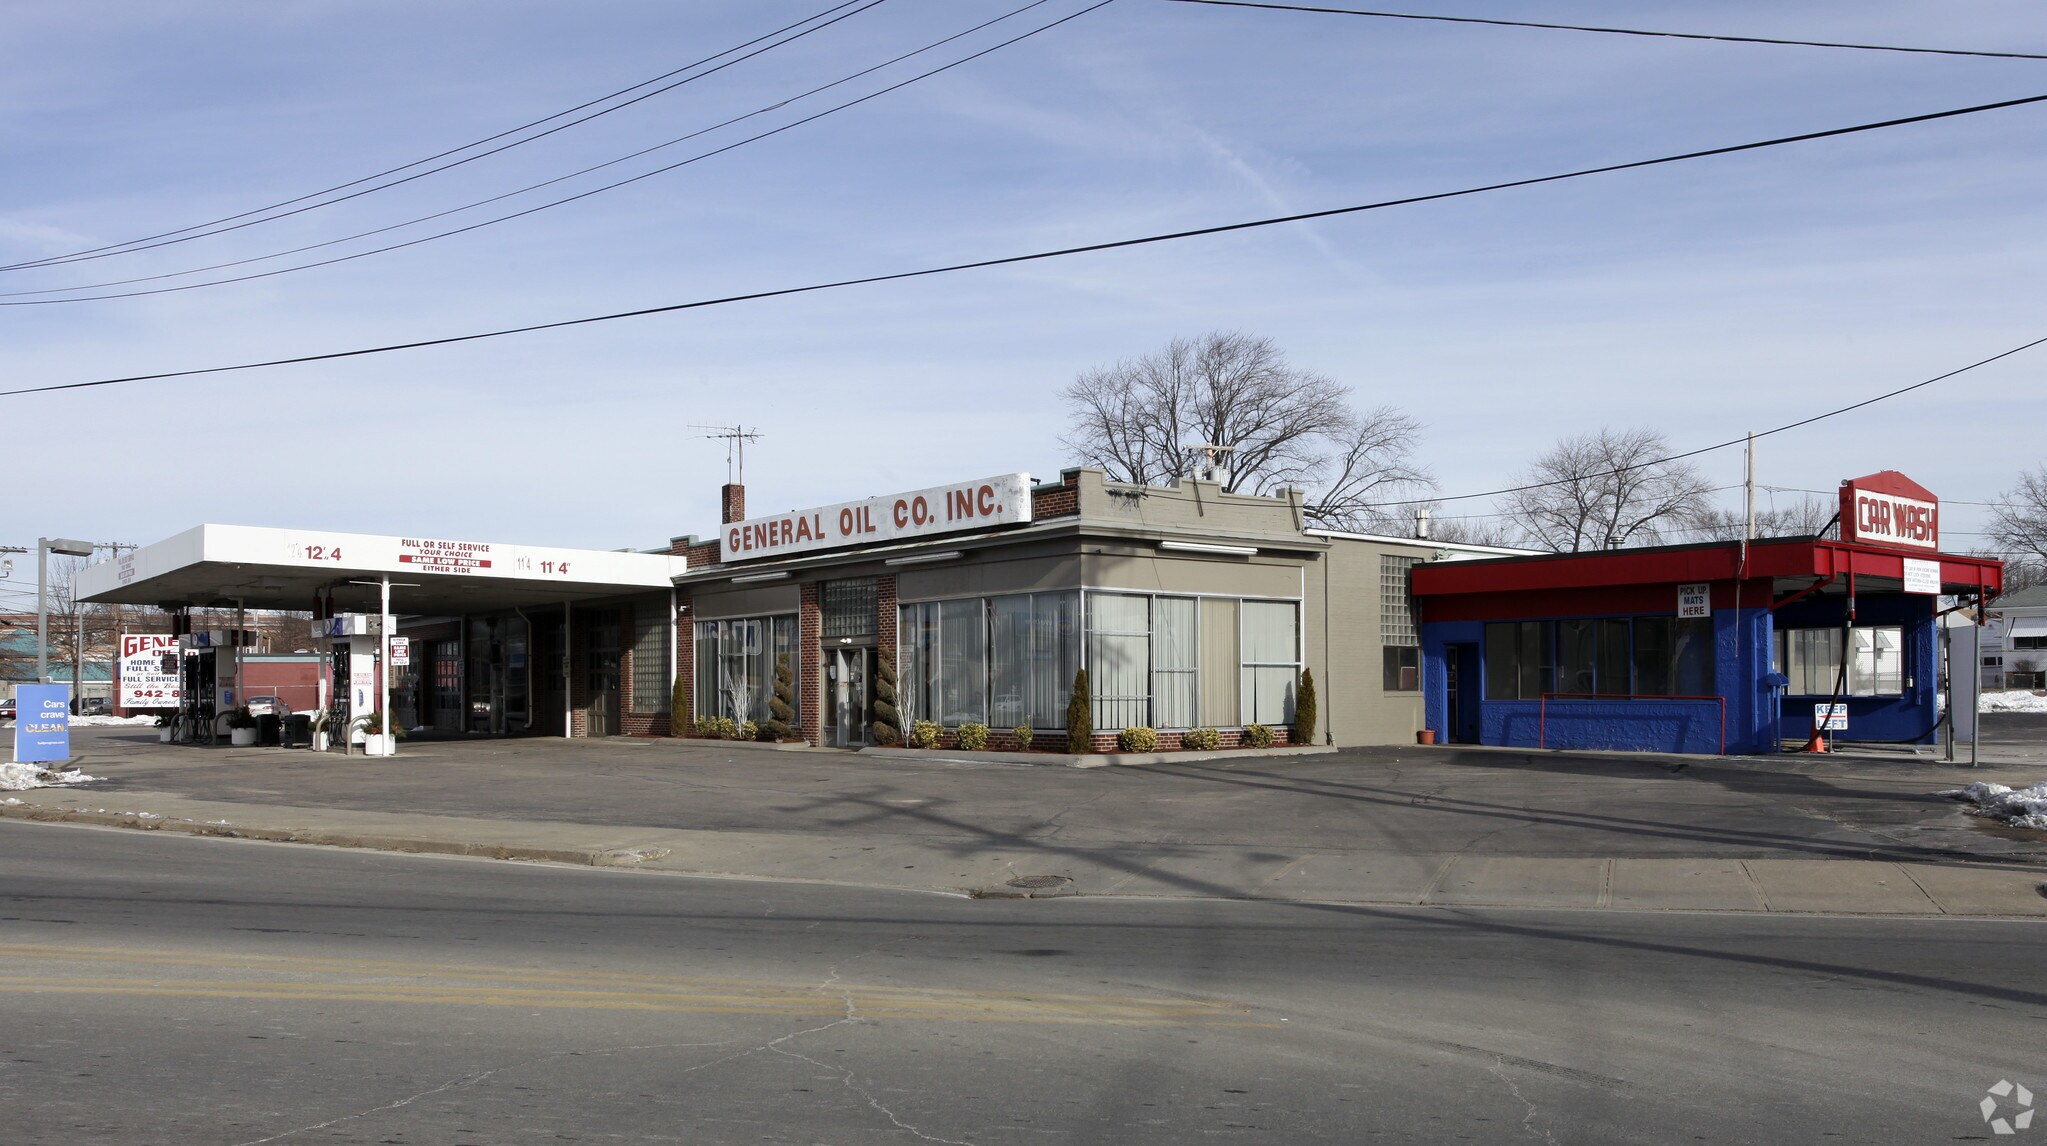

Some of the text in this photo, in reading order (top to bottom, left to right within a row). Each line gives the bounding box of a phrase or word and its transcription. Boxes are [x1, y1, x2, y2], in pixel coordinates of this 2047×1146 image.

[729, 484, 1003, 553] GENERAL OIL CO. INC.
[1858, 496, 1935, 542] CAR WASH
[401, 539, 420, 547] FULL
[438, 541, 455, 550] SELF
[458, 543, 490, 552] SERVICE
[411, 556, 435, 564] SAME
[457, 559, 481, 567] PRICE
[1680, 586, 1707, 595] PICK UP
[1683, 596, 1704, 605] MATS
[1683, 606, 1705, 615] HERE
[124, 637, 179, 658] GENE
[43, 700, 65, 709] Cars
[123, 698, 149, 706] Family
[41, 711, 65, 719] crave
[25, 723, 67, 733] CLEAN.
